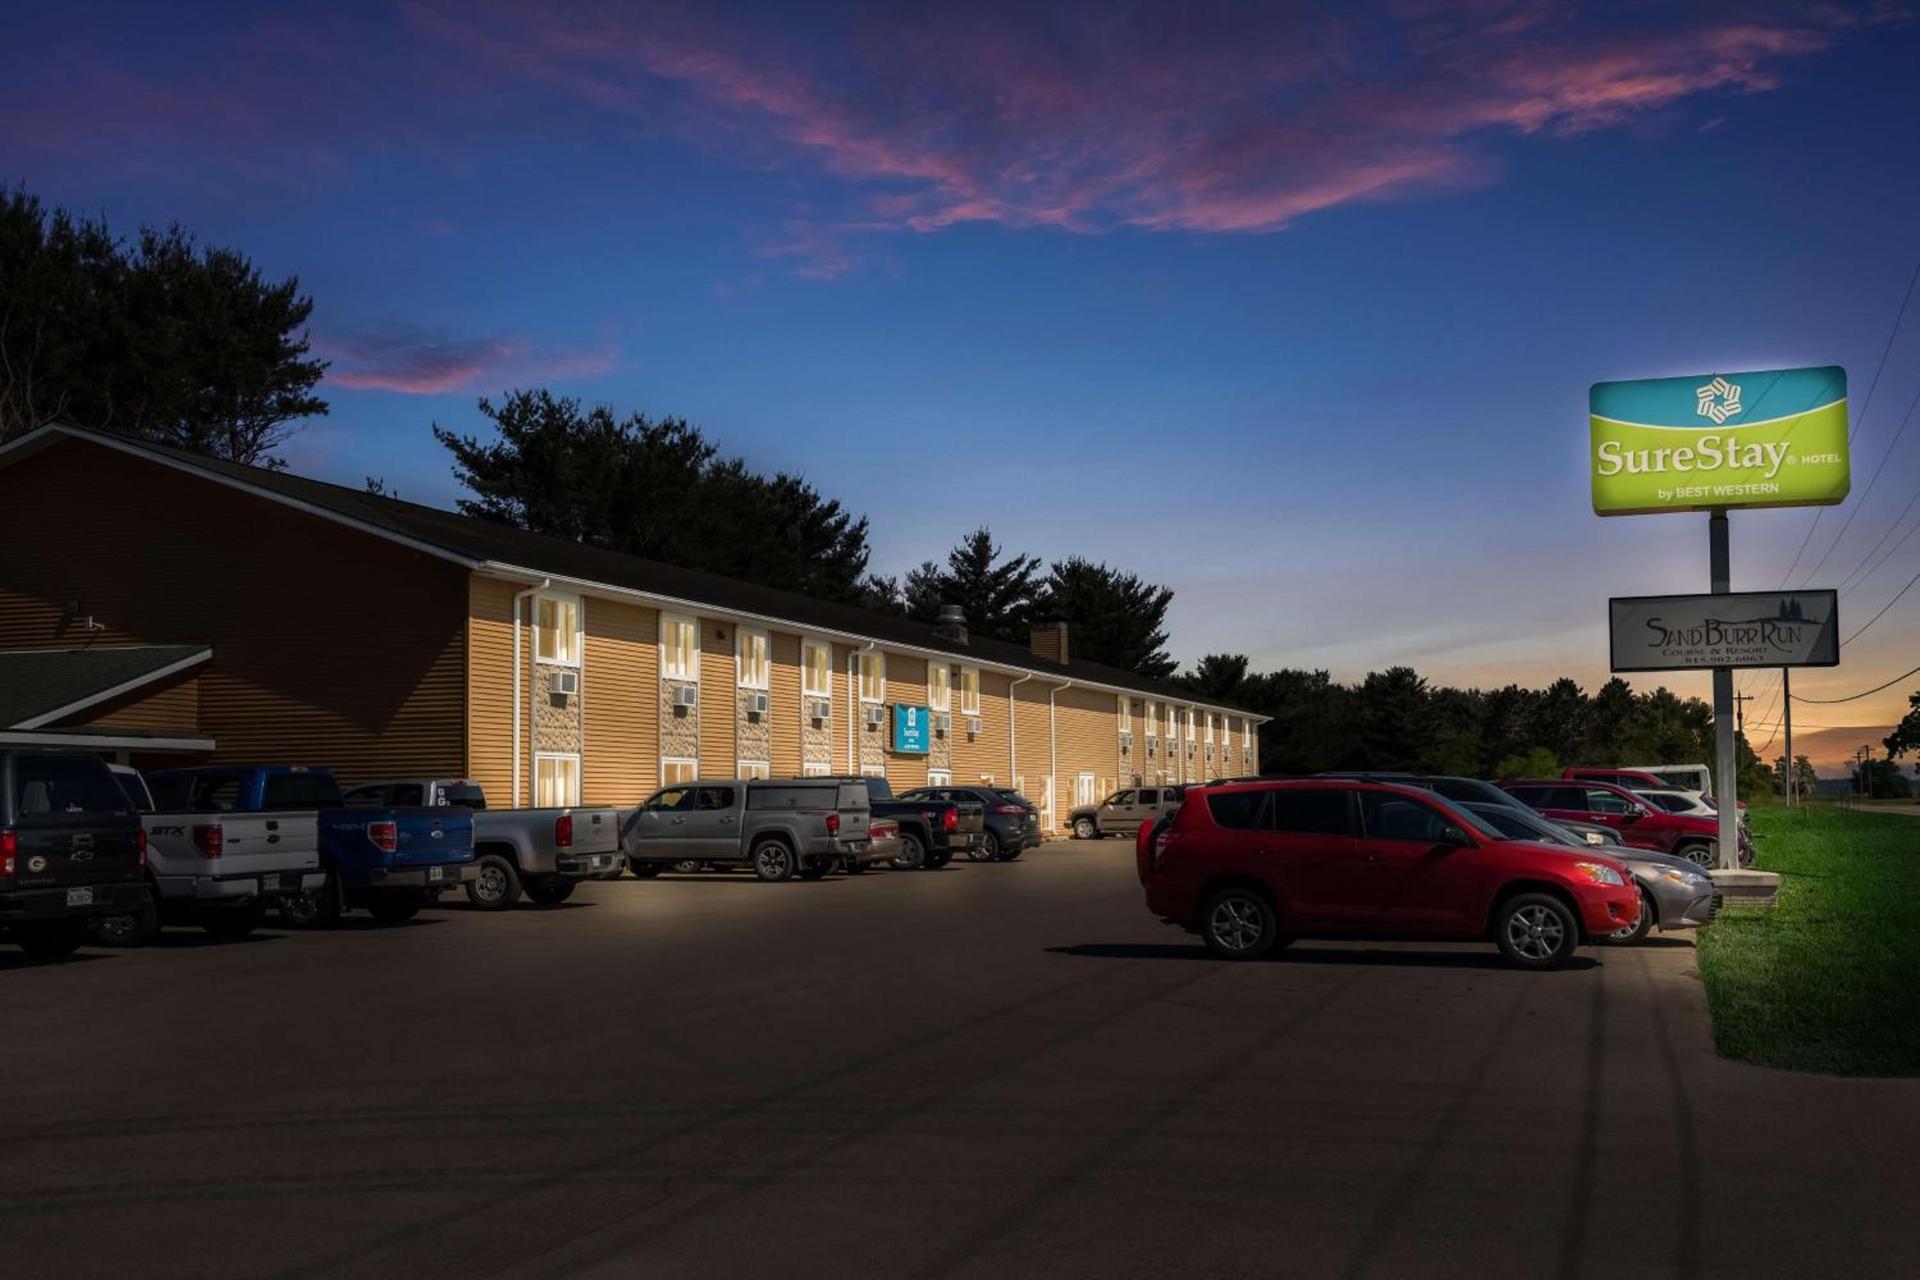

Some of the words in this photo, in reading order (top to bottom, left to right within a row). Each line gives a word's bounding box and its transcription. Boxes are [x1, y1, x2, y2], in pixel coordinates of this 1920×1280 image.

[1802, 453, 1842, 465] HOTEL
[1658, 487, 1673, 501] by
[1676, 486, 1710, 497] BEST
[1713, 483, 1779, 496] WESTERN
